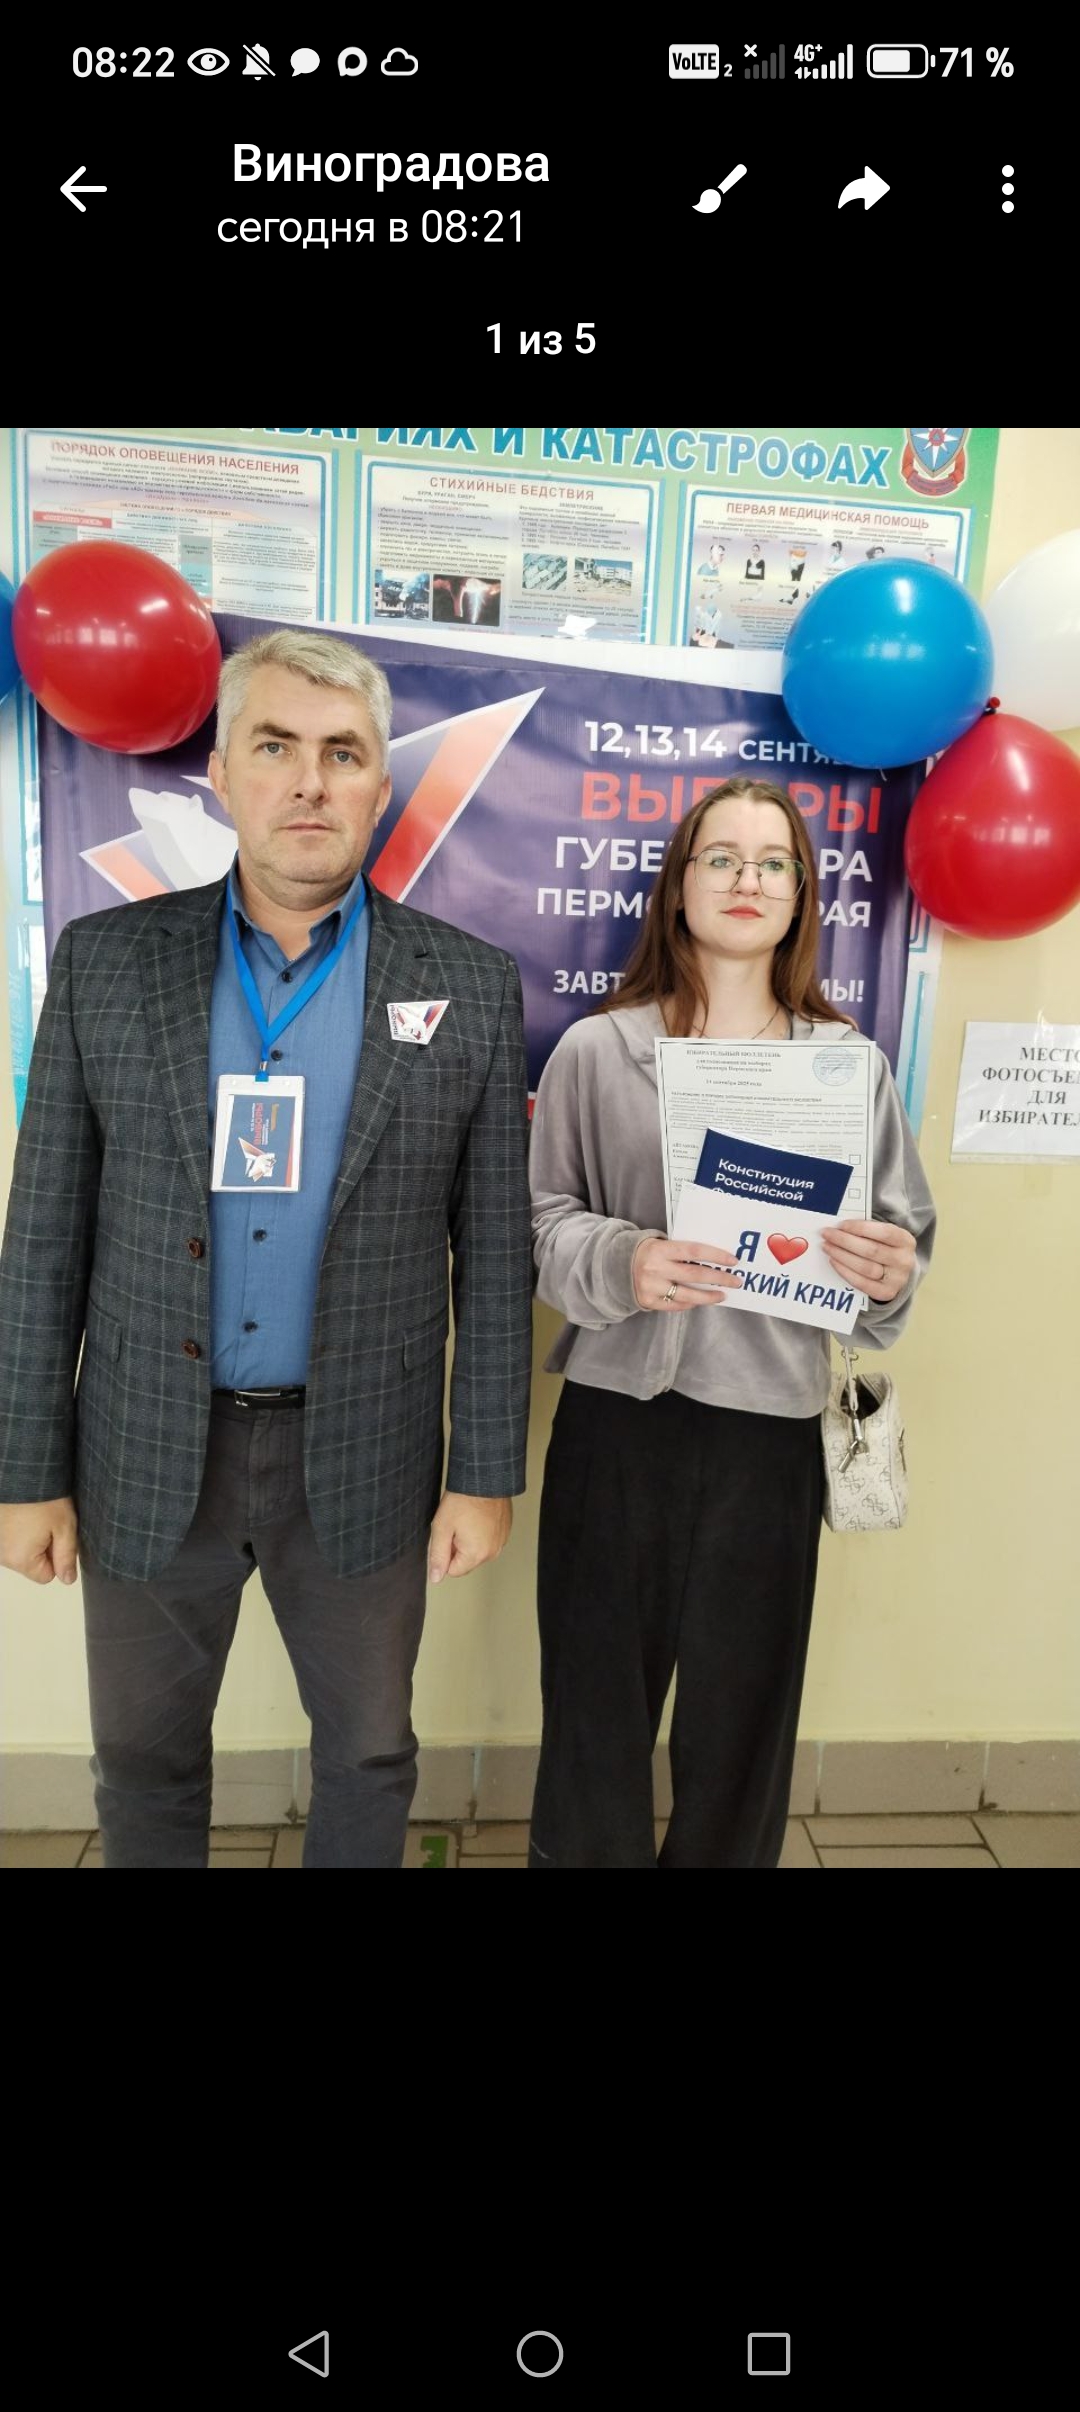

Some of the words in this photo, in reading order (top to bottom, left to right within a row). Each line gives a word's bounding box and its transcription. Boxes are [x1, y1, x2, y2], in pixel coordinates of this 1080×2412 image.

[51, 441, 116, 457] ПОРЯДОК
[119, 447, 215, 466] ОПОВЕЩЕНИЯ
[219, 457, 300, 475] НАСЕЛЕНИЯ
[541, 428, 891, 488] КАТАСТРОФАХ
[429, 476, 517, 494] СТИХИЙНЫЕ
[521, 484, 595, 500] БЕДСТВИЯ
[726, 502, 776, 516] ПЕРВАЯ
[779, 506, 871, 524] МЕДИЦИНСКАЯ
[874, 514, 930, 530] ПОМОЩЬ
[584, 720, 728, 760] 12,13,14
[738, 739, 845, 765] СЕНТЯ
[581, 771, 882, 834] ВЫРЫ
[555, 836, 874, 882] ГУБЕРА
[552, 969, 626, 995] ЗАВТ
[982, 1067, 1080, 1085] ФОТОСЪЕ
[1026, 1090, 1068, 1106] ДЛЯ
[978, 1109, 1080, 1127] ИЗБИРАТЕ
[714, 1172, 804, 1202] Российской
[718, 1158, 816, 1190] Конституция
[735, 1230, 761, 1263] Я
[793, 1281, 856, 1314] КРАЙ
